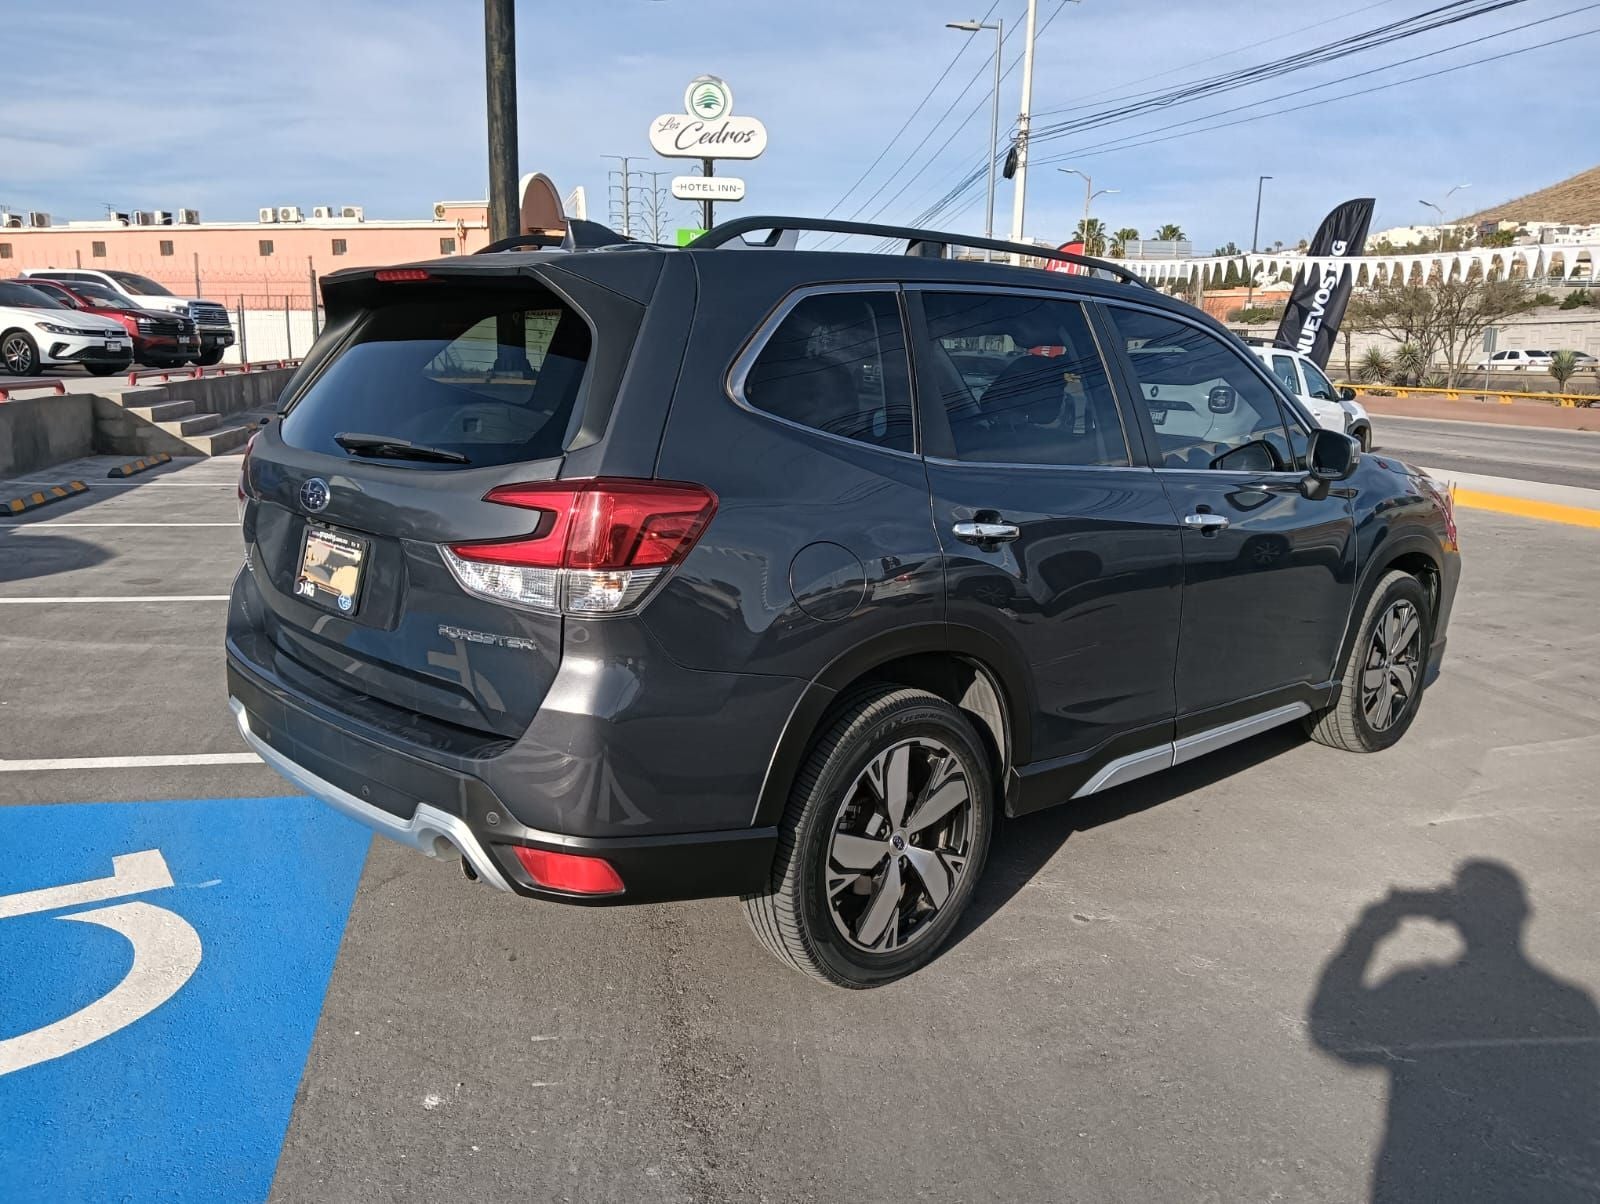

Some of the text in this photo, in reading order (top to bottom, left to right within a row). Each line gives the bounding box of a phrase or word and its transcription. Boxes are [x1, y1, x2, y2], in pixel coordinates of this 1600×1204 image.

[658, 116, 757, 151] Los Cedros
[438, 624, 537, 650] FORESTER
